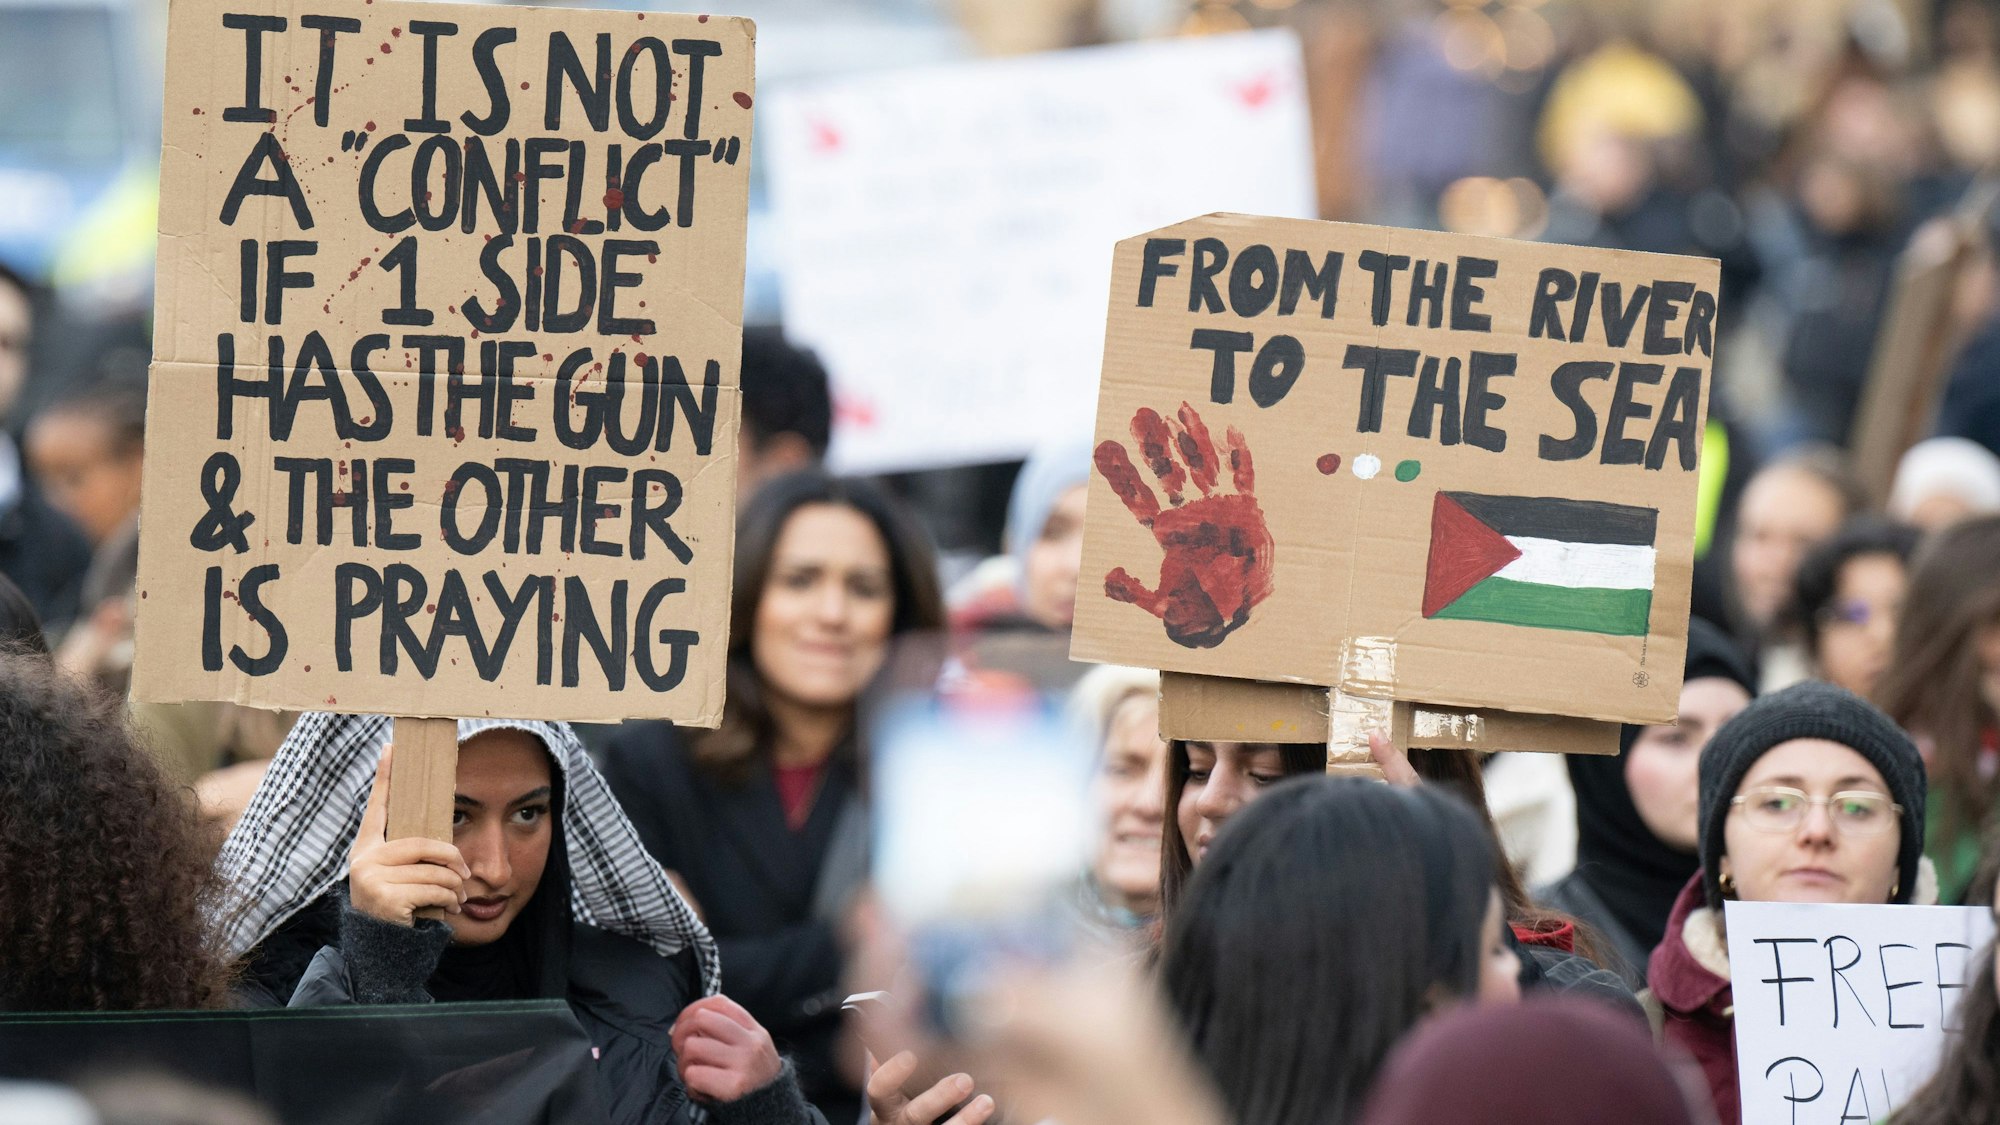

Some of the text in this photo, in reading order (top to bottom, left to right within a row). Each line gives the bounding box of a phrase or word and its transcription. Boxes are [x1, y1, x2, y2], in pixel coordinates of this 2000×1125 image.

[222, 13, 722, 140] IT IS NOT
[219, 133, 314, 230] A
[341, 130, 740, 234] "CONFLICT"
[240, 233, 660, 335] IF 1 SIDE
[1137, 238, 1344, 319] FROM
[1358, 249, 1499, 332] THE
[1528, 267, 1716, 358] RIVER
[217, 330, 720, 456] HAS THE GUN
[1190, 329, 1703, 472] TO THE SEA
[190, 451, 694, 564] & THE OTHER
[202, 562, 698, 692] IS PRAYING
[1753, 935, 1972, 1033] FREE
